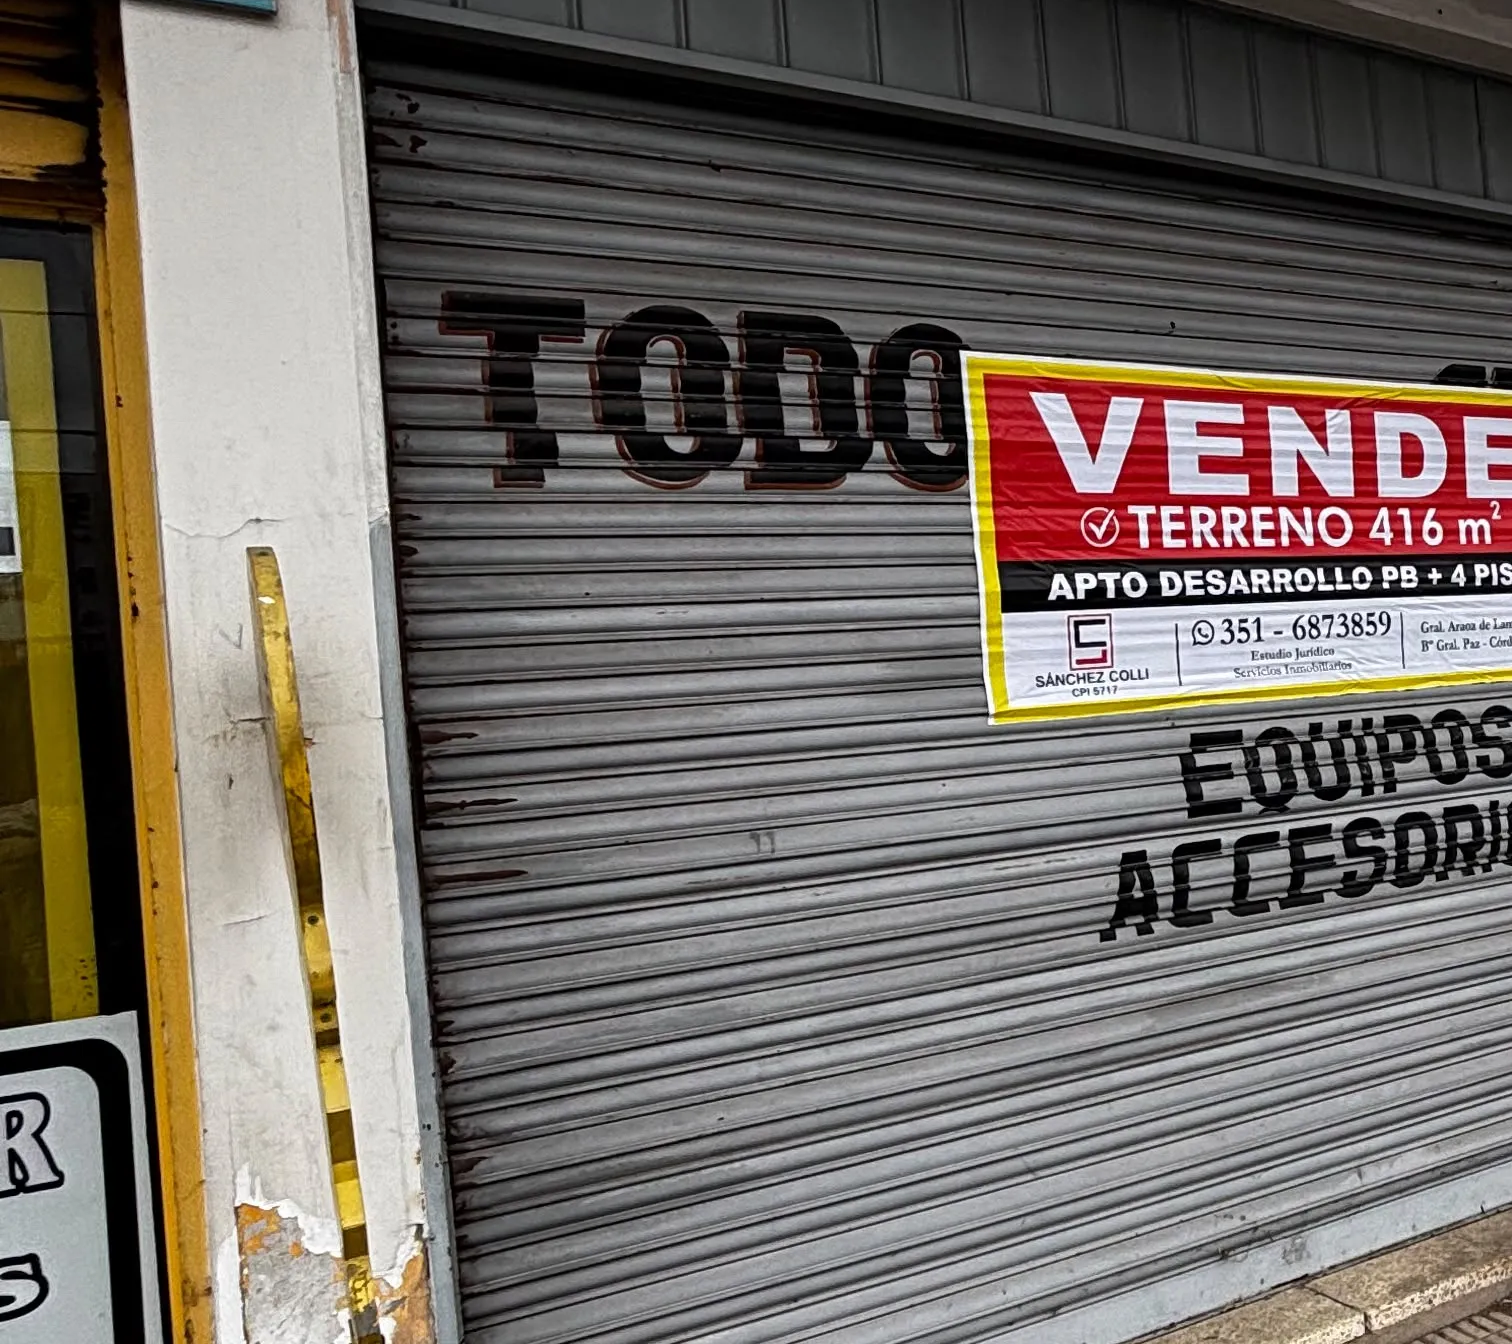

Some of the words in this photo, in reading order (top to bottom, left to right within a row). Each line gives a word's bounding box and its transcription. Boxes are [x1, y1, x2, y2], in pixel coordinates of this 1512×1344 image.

[437, 290, 969, 492] TODO
[1127, 505, 1354, 549] TERRENO
[1368, 506, 1444, 546] 416
[1048, 571, 1148, 601] APTO
[1159, 566, 1373, 597] DESARROLLO
[1382, 565, 1419, 589] PB
[1427, 567, 1443, 585] +
[1450, 564, 1467, 587] 4
[1220, 617, 1265, 646] 351
[1292, 611, 1392, 641] 6873859
[1420, 620, 1446, 634] Gral.
[1479, 619, 1491, 631] de
[1436, 638, 1461, 652] Gral.
[1462, 637, 1481, 650] Paz
[1250, 650, 1292, 662] Estudio
[1294, 647, 1335, 661] Jurídico
[1035, 672, 1105, 688] SÁNCHEZ
[1108, 668, 1149, 682] COLLI
[1233, 666, 1282, 679] Servicios
[1284, 661, 1353, 675] Inmobiliarios
[1071, 688, 1090, 698] CPI
[1093, 685, 1118, 696] 5717
